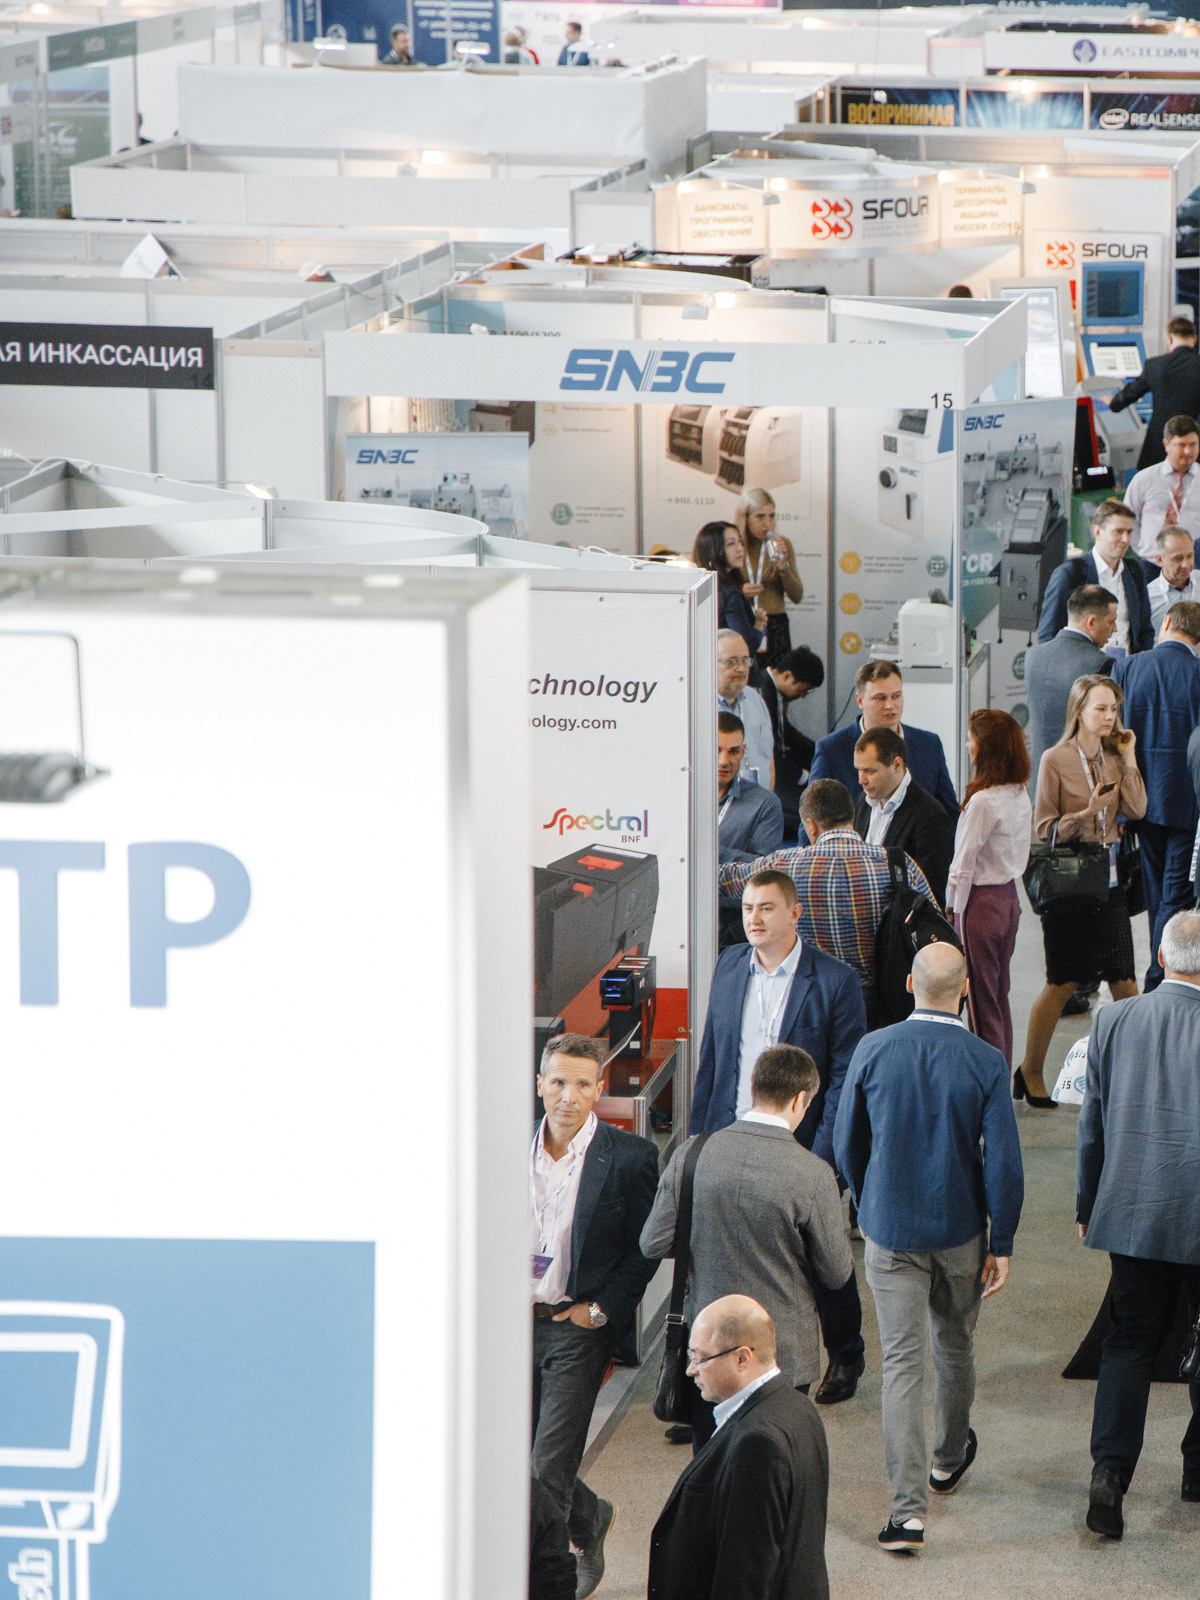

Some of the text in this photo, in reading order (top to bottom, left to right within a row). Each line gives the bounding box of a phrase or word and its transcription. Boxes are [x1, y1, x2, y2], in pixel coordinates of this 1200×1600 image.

[862, 195, 928, 220] SFOUR
[1082, 243, 1148, 258] SFOUR
[29, 342, 204, 372] ИНКАССАЦИЯ
[559, 348, 736, 394] SNBC
[931, 393, 953, 409] 15
[964, 413, 1006, 431] SNBC
[356, 449, 419, 464] SNBC
[529, 673, 658, 704] chnology
[528, 714, 617, 732] ology.com
[543, 807, 648, 838] Spectral
[621, 835, 641, 843] BNF
